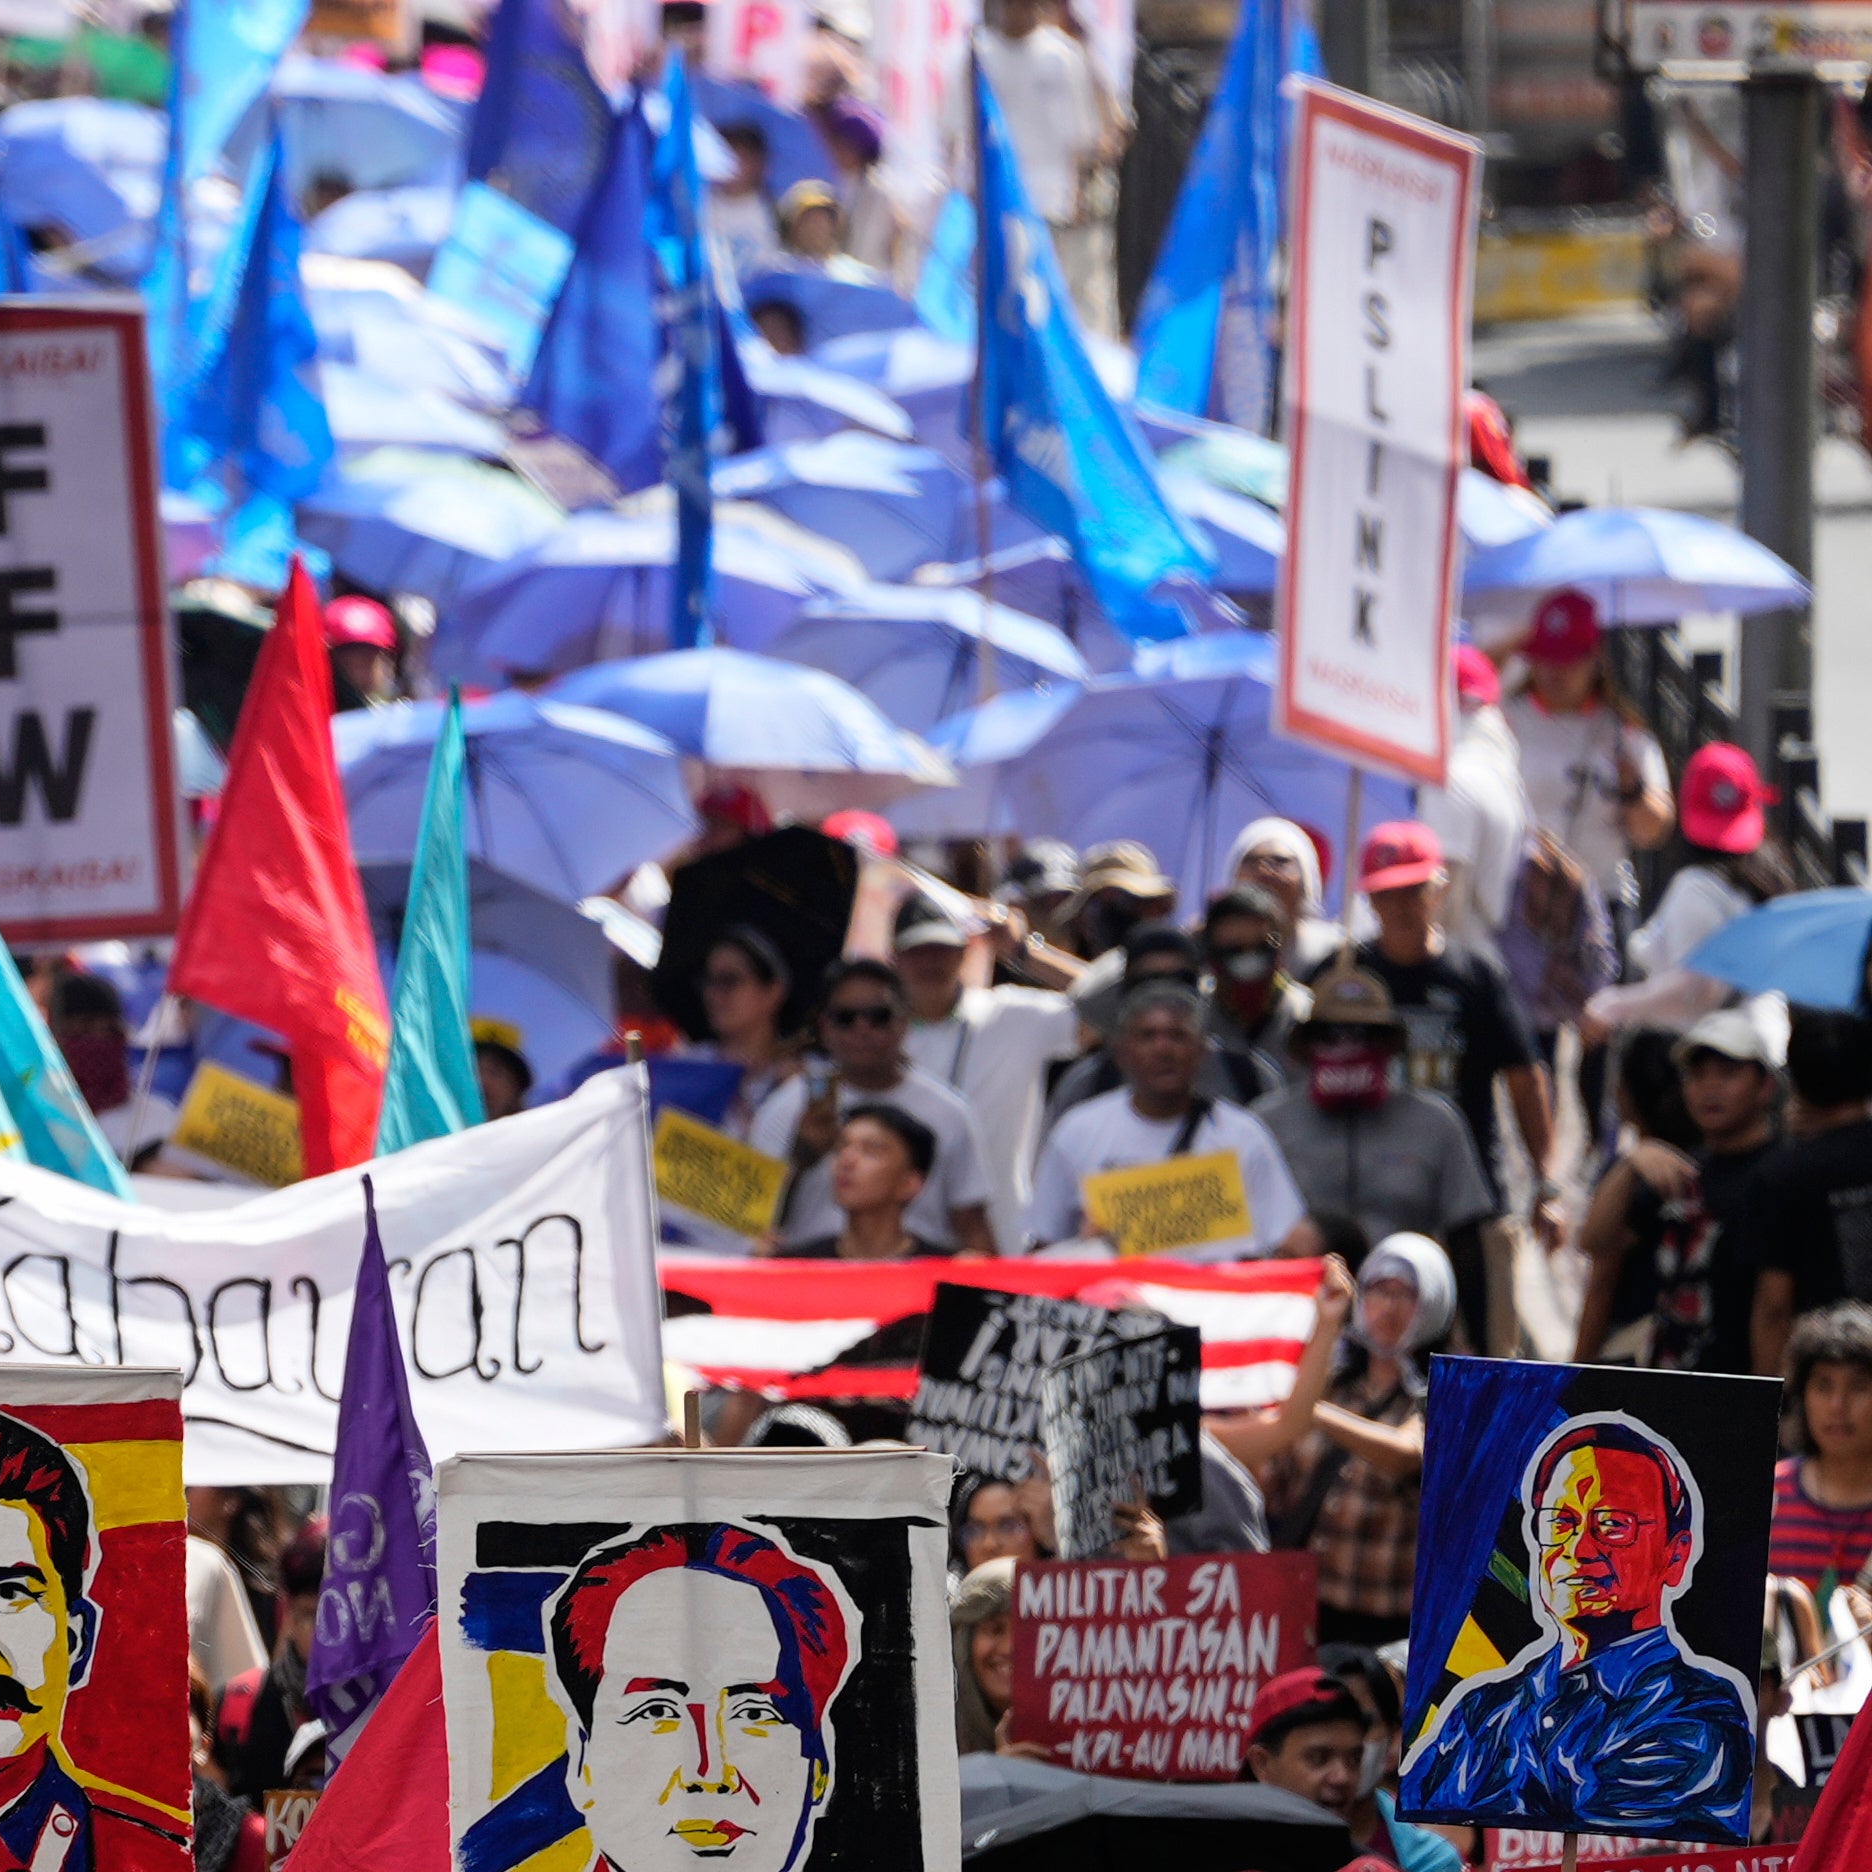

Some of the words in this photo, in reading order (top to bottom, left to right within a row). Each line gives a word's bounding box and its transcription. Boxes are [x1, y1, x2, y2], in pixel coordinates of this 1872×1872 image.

[1350, 219, 1396, 648] PSLINK
[1019, 1566, 1167, 1620] MILITAR
[1185, 1561, 1241, 1614] SA
[1035, 1611, 1280, 1678] PAMANTASAN
[1049, 1675, 1256, 1729] PALAYASIN!!
